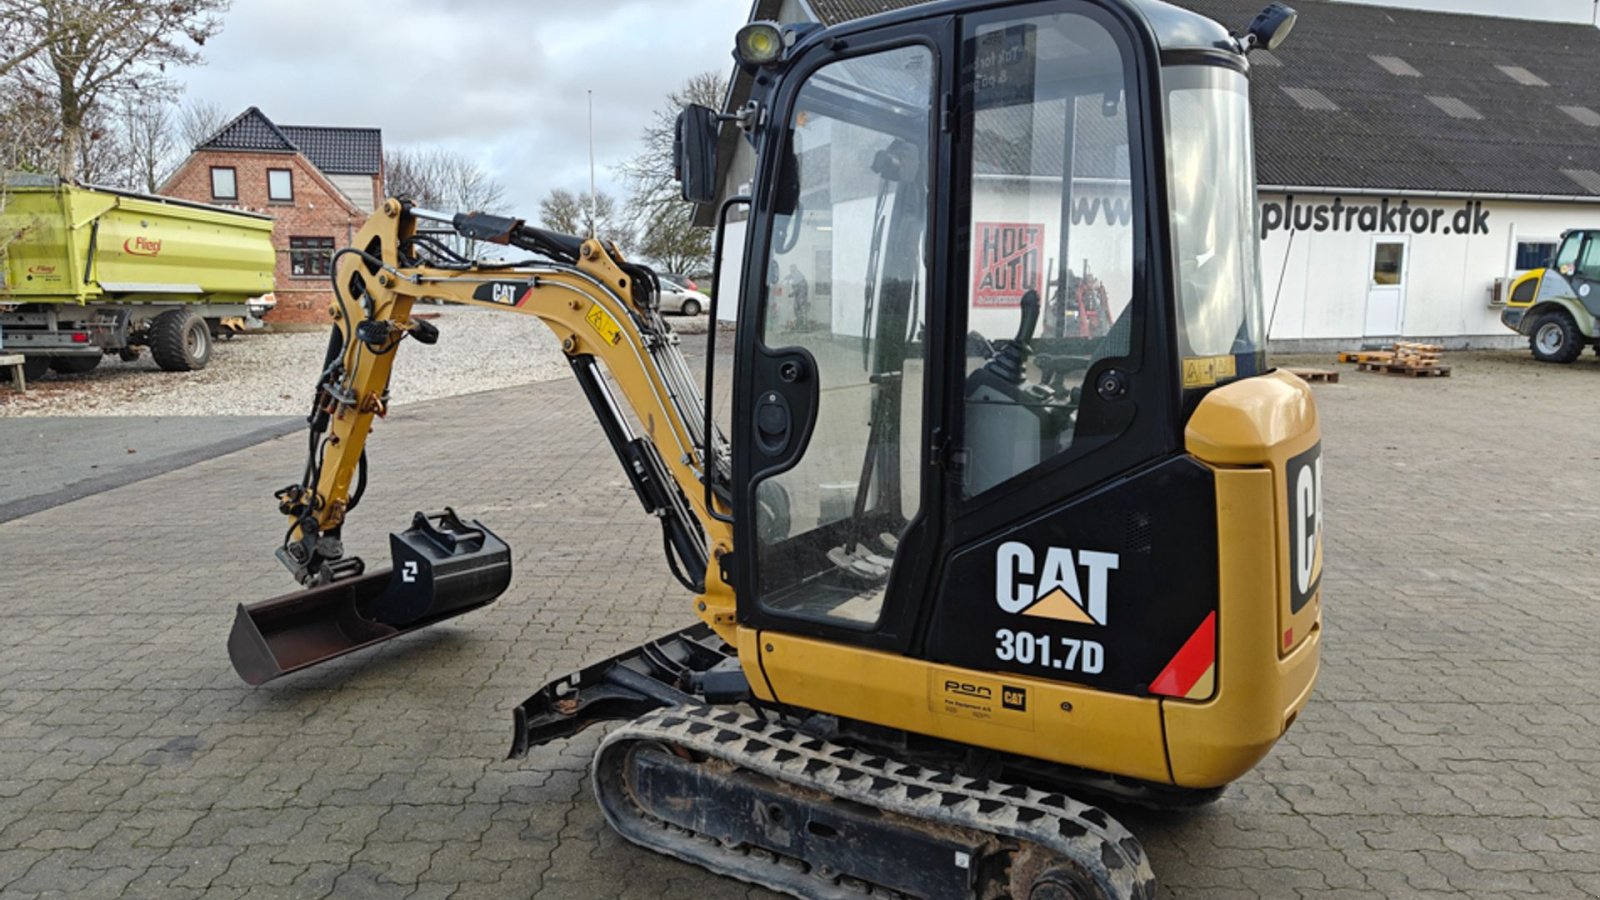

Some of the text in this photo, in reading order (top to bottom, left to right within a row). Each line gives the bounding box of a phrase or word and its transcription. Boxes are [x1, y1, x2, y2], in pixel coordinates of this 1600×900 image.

[1260, 195, 1490, 240] plustraktor.dk
[135, 236, 162, 257] Fliegl
[983, 227, 1039, 271] HOLT
[979, 247, 1038, 291] AUTO
[492, 283, 516, 304] CAT
[996, 541, 1119, 626] CAT
[995, 628, 1104, 674] 301.7D
[1004, 691, 1024, 706] CAT
